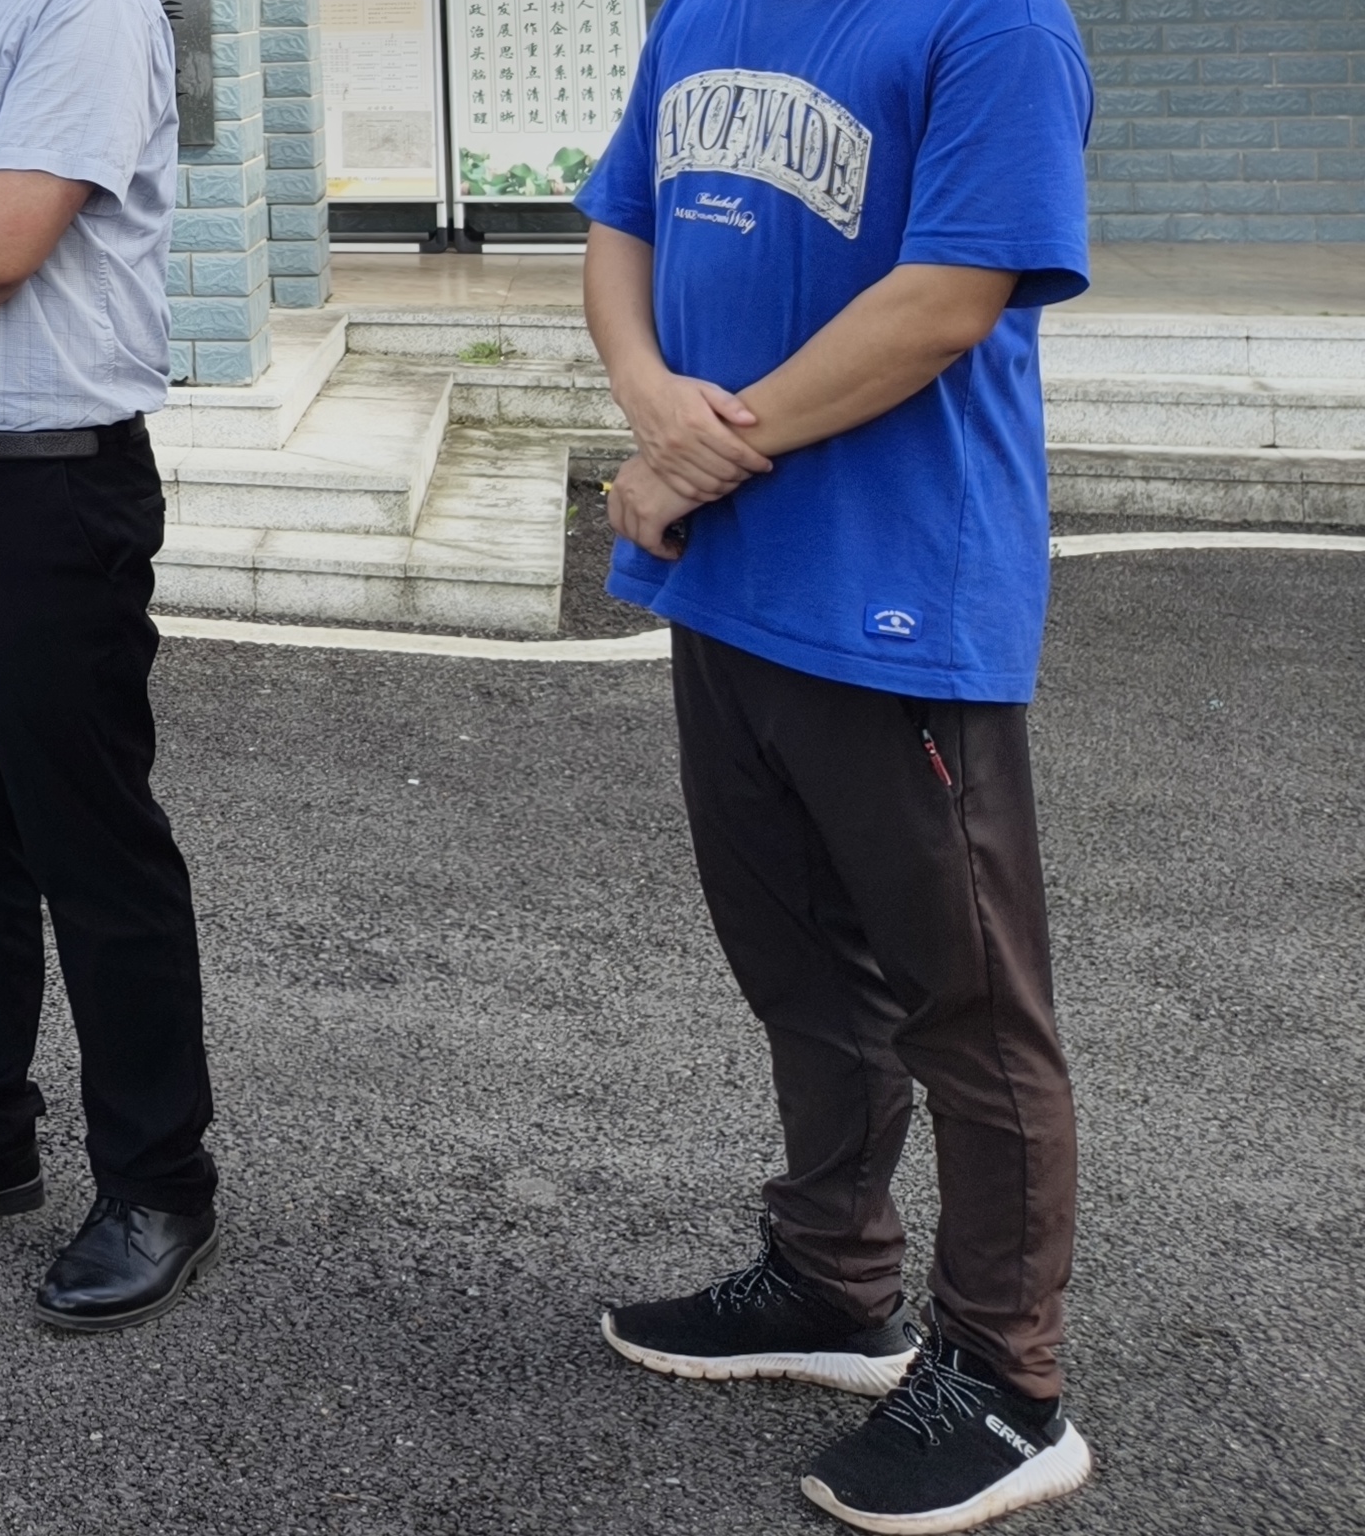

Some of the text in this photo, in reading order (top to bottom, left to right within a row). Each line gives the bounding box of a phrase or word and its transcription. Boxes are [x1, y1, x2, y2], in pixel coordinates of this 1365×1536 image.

[469, 4, 488, 124] 政治头脑清醒
[497, 2, 515, 124] 发展思路清晰
[523, 2, 544, 124] 工作重点清楚
[985, 1414, 1037, 1459] ERKE
